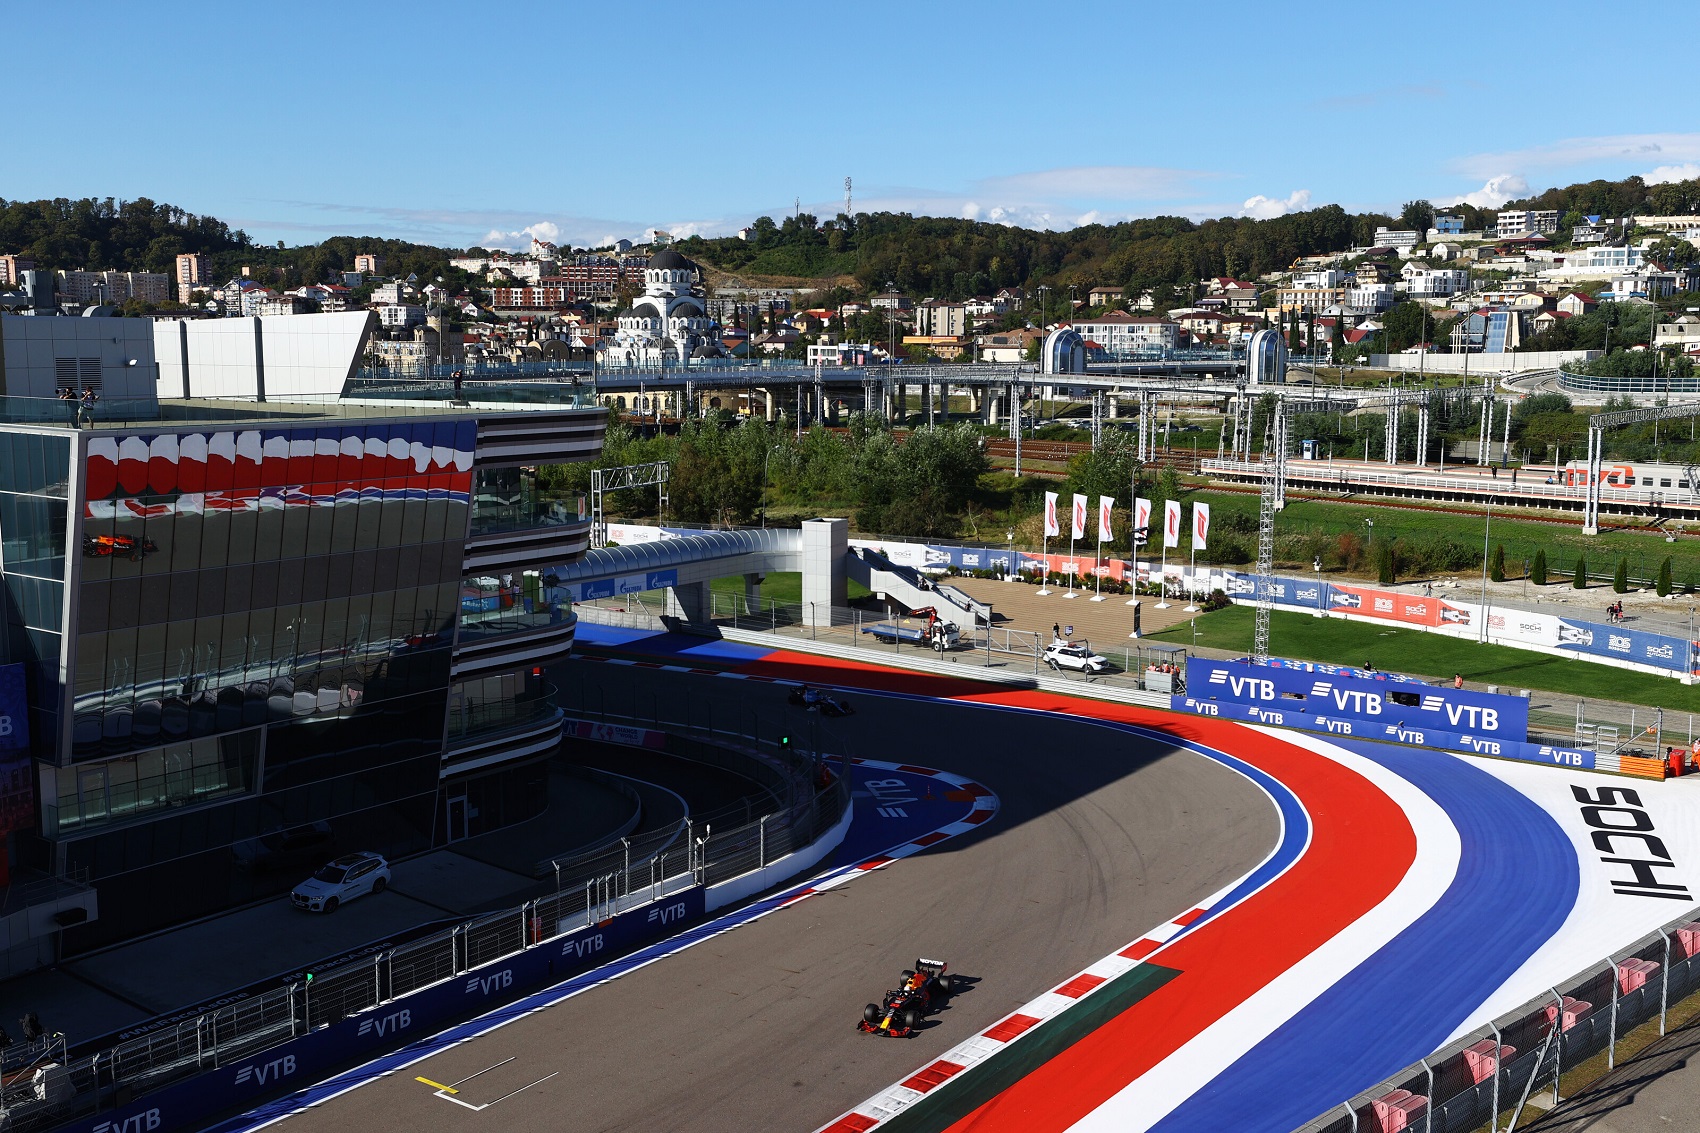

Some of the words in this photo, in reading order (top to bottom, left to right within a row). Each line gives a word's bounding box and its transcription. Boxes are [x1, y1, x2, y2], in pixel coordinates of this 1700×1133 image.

[1519, 623, 1542, 631] SOCHI
[1647, 645, 1673, 656] SOCHI
[1230, 675, 1275, 701] VTB
[1195, 702, 1219, 716] VTB
[1333, 688, 1382, 715] VTB
[1259, 710, 1284, 724] VTB
[1326, 719, 1352, 734] VTB
[1445, 702, 1499, 731] VTB
[1397, 730, 1424, 745] VTB
[1472, 740, 1501, 755] VTB
[1552, 750, 1582, 766] VTB
[864, 778, 919, 806] VTB
[1570, 784, 1694, 901] SOCHI
[659, 902, 686, 925] VTB
[574, 933, 604, 958] VTB
[480, 969, 513, 996] VTB
[117, 992, 251, 1040] #WeRaceAsOne
[374, 1008, 412, 1038] VTB
[254, 1054, 297, 1086] VTB
[112, 1107, 161, 1133] VTB
